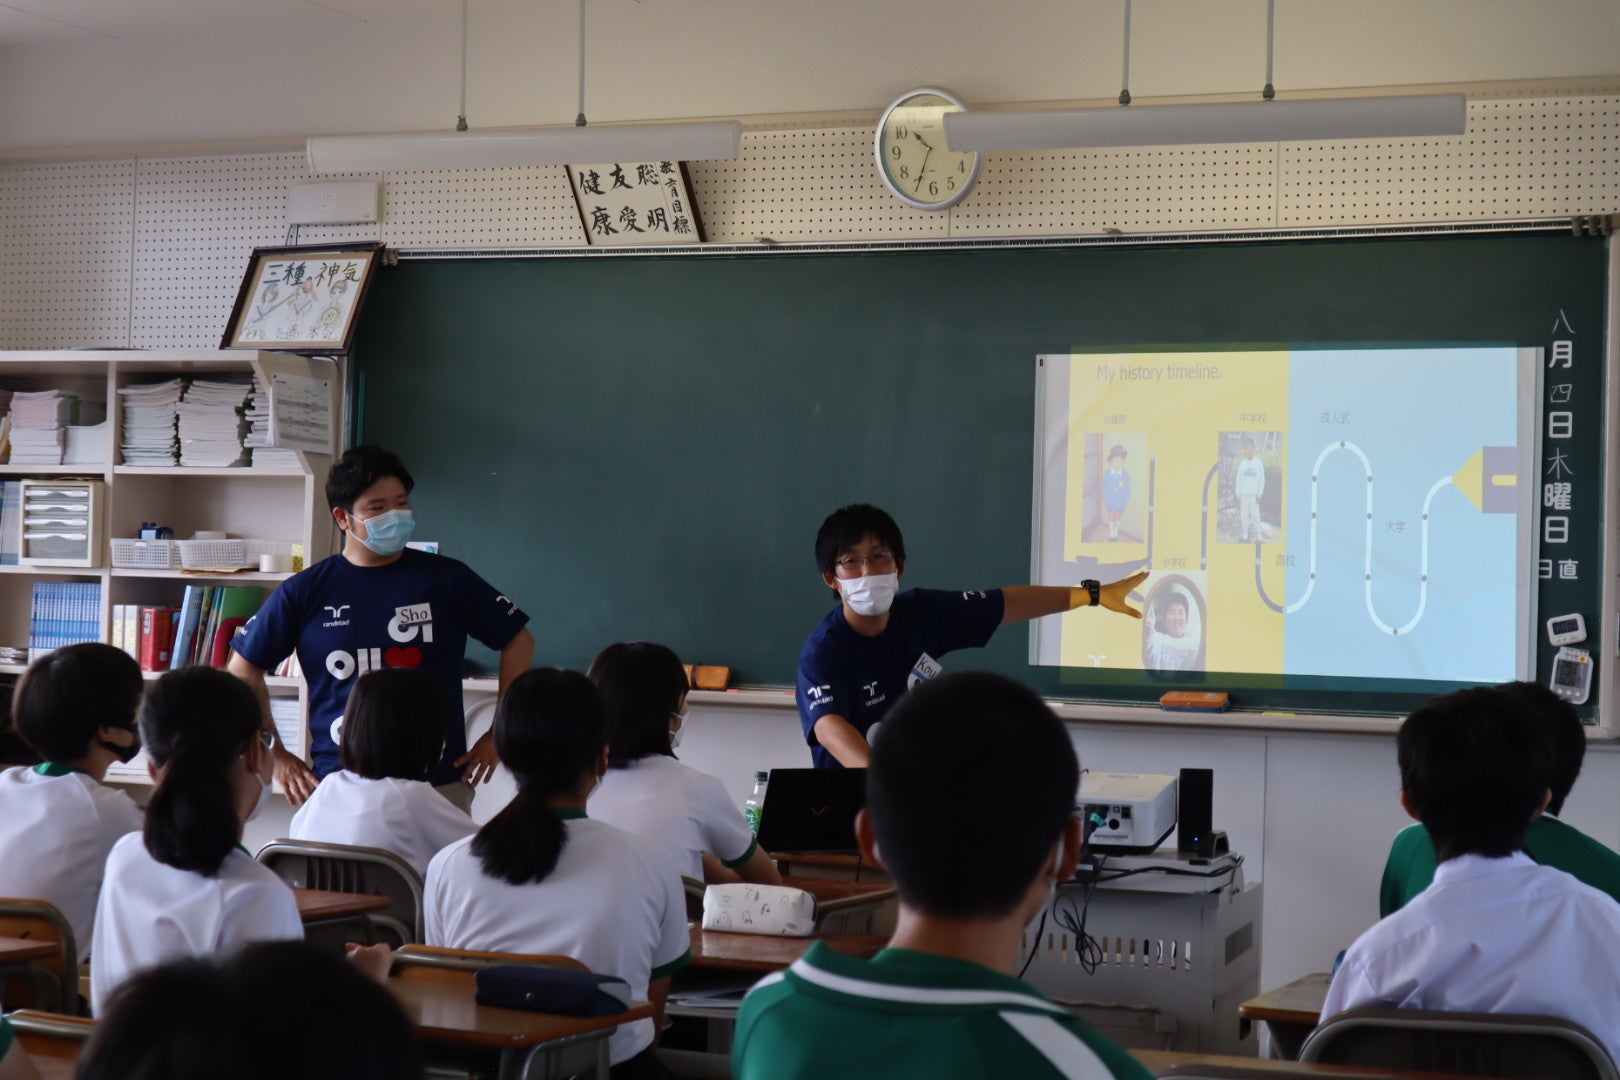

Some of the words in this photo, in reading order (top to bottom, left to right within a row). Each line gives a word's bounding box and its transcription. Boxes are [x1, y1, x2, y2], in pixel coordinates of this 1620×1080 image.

[896, 126, 908, 140] 10
[891, 146, 901, 160] 9
[900, 165, 909, 179] 8
[957, 160, 965, 173] 4
[929, 181, 938, 196] 6
[947, 177, 955, 190] 5
[1097, 365, 1115, 384] My
[1119, 364, 1162, 384] history
[1167, 363, 1221, 380] timeline.
[1386, 520, 1406, 533] 大学
[400, 608, 428, 624] Sho
